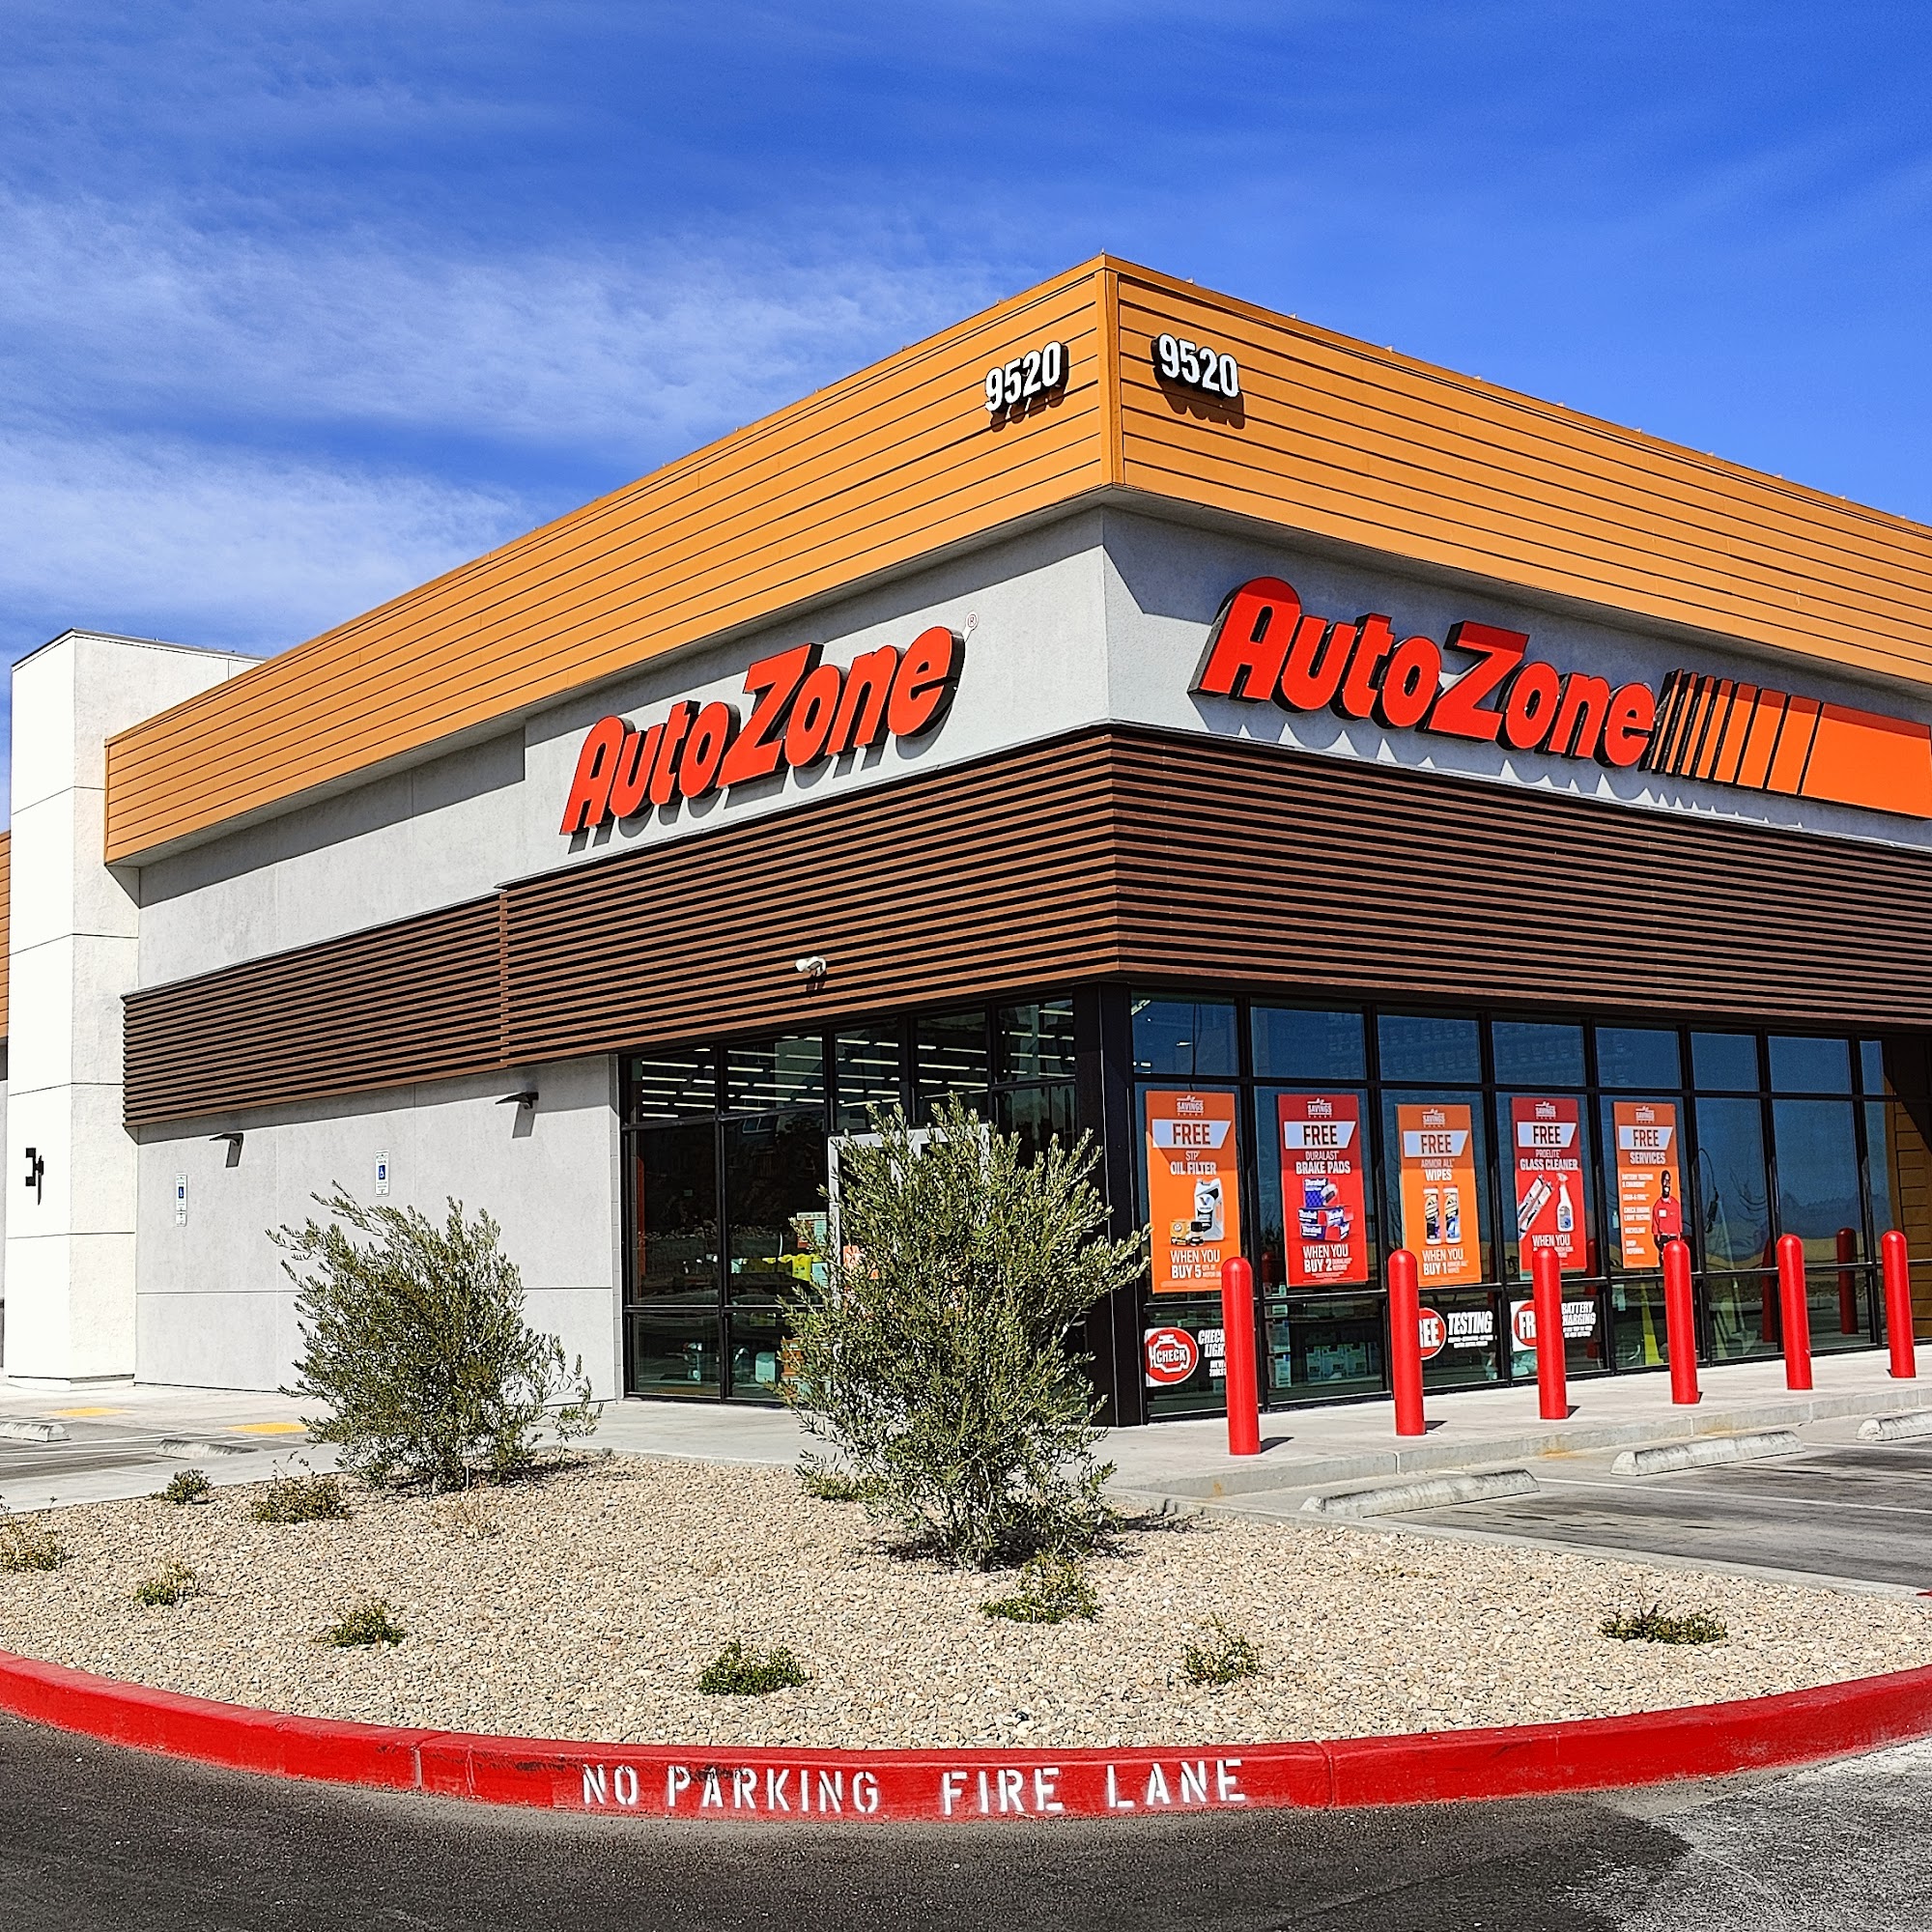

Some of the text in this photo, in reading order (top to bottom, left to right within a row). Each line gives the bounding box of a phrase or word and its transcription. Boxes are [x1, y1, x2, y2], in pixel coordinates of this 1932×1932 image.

[1159, 333, 1239, 397] 9520
[985, 341, 1062, 412] 9520
[1192, 577, 1657, 769] AutoZone
[559, 626, 962, 836] AutoZone
[1173, 1123, 1210, 1145] FREE
[1302, 1125, 1338, 1146] FREE
[1533, 1125, 1561, 1145] FREE
[1633, 1129, 1660, 1147] FREE
[1421, 1135, 1452, 1154] FREE
[1305, 1151, 1338, 1161] DURALAST
[1630, 1151, 1666, 1165] SERVICES
[1170, 1161, 1217, 1175] OIL FILTER
[1295, 1160, 1351, 1175] BRAKE PADS
[1520, 1158, 1578, 1171] GLASS CLEANER
[1425, 1169, 1452, 1181] WIPES
[1532, 1235, 1570, 1246] WHEN YOU
[1170, 1249, 1220, 1264] WHEN YOU
[1302, 1243, 1349, 1259] WHEN YOU
[1422, 1248, 1463, 1262] WHEN YOU
[1171, 1264, 1193, 1279] BUY
[1194, 1264, 1202, 1278] 5
[1304, 1259, 1333, 1273] BUY 2
[1423, 1262, 1447, 1276] BUY 1
[1561, 1301, 1594, 1314] BATTERY
[1447, 1311, 1493, 1335] TESTING
[1562, 1313, 1596, 1326] HARGING
[1156, 1349, 1186, 1363] CHECK
[1205, 1343, 1225, 1357] LIGH
[582, 1758, 1245, 1815] NO PARKING FIRE LANE
